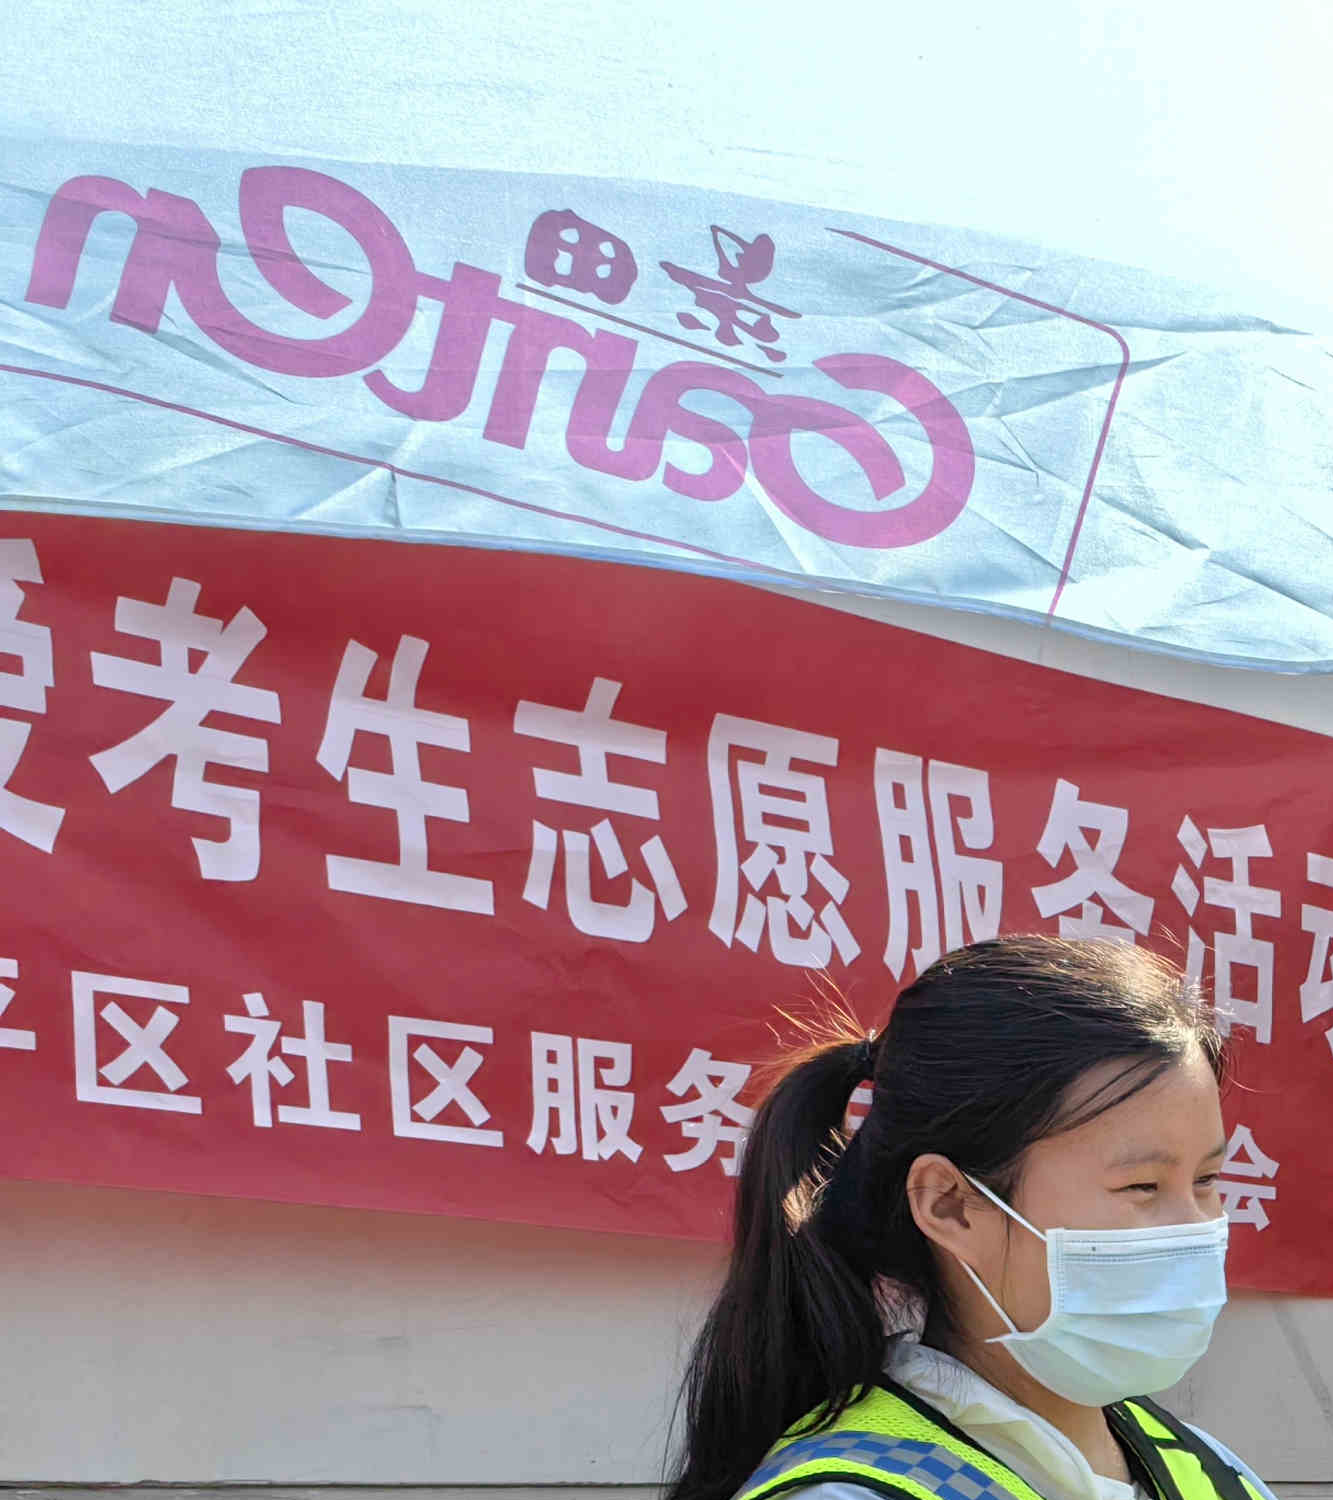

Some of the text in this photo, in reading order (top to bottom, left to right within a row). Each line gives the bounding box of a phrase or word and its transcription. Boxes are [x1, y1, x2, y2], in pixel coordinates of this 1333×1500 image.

[0, 957, 757, 1177] 区社区服务
